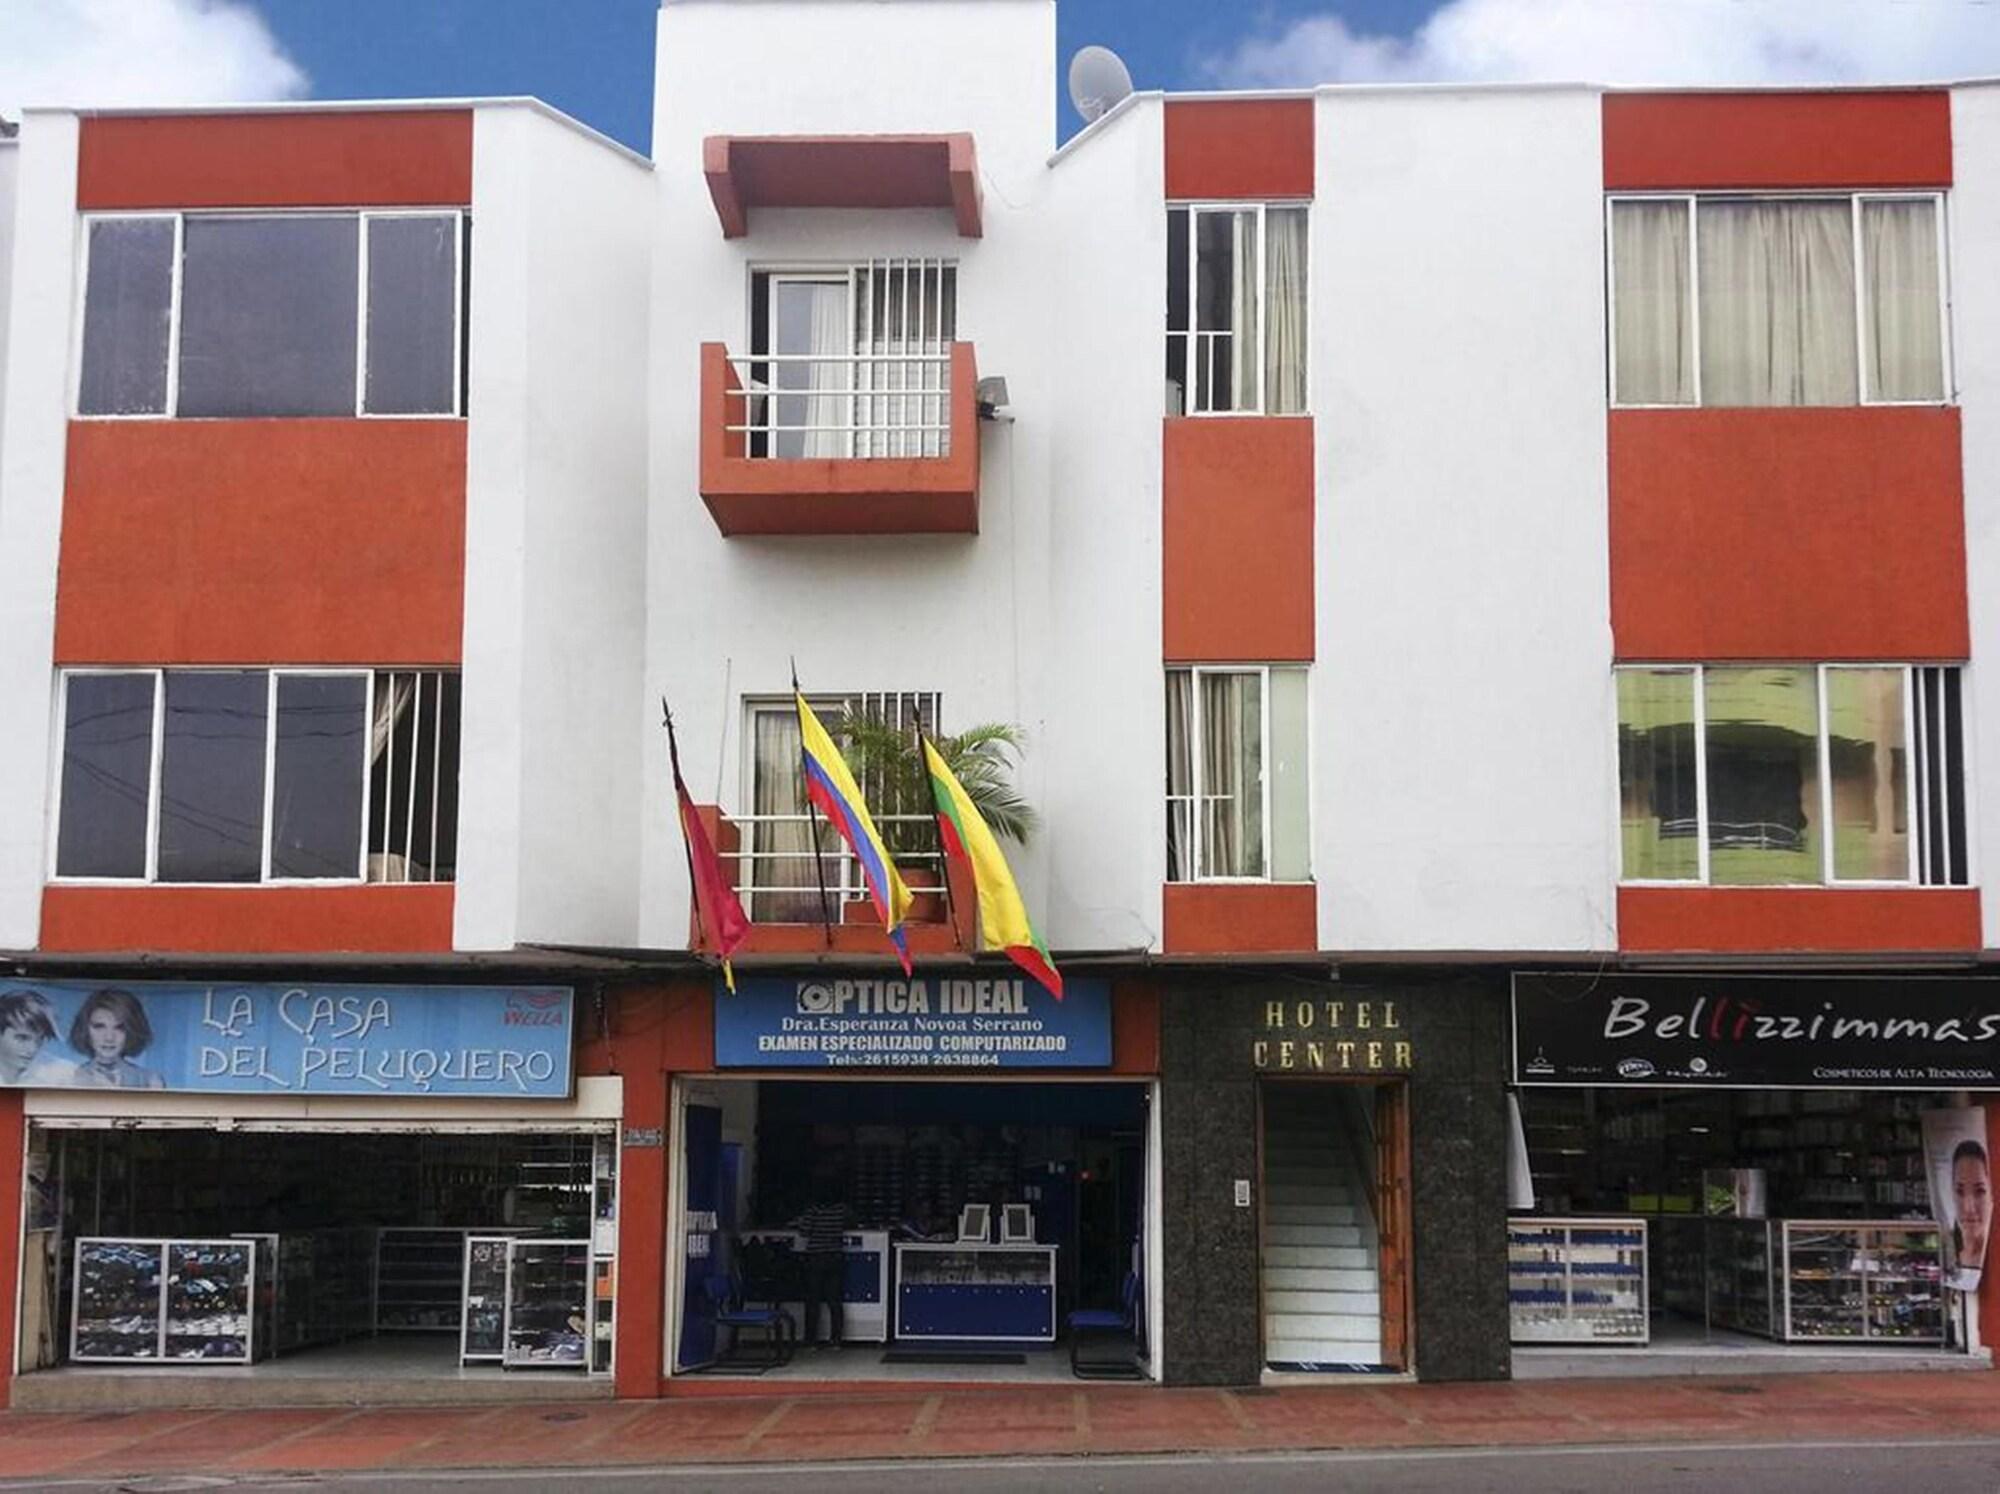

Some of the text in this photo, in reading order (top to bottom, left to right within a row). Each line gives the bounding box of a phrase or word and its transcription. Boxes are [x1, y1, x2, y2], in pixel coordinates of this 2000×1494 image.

[940, 979, 1029, 1014] IDEAL
[202, 986, 390, 1043] LA CASA
[914, 1017, 967, 1031] Novoa
[972, 1017, 1043, 1031] Serrano
[1266, 1002, 1399, 1028] HOTEL
[758, 1035, 1066, 1051] EXAMEN ESPECIALIZADO COMPUTARIZADO
[1254, 1041, 1412, 1068] CENTER
[201, 1045, 554, 1092] DEL PELUQUERO
